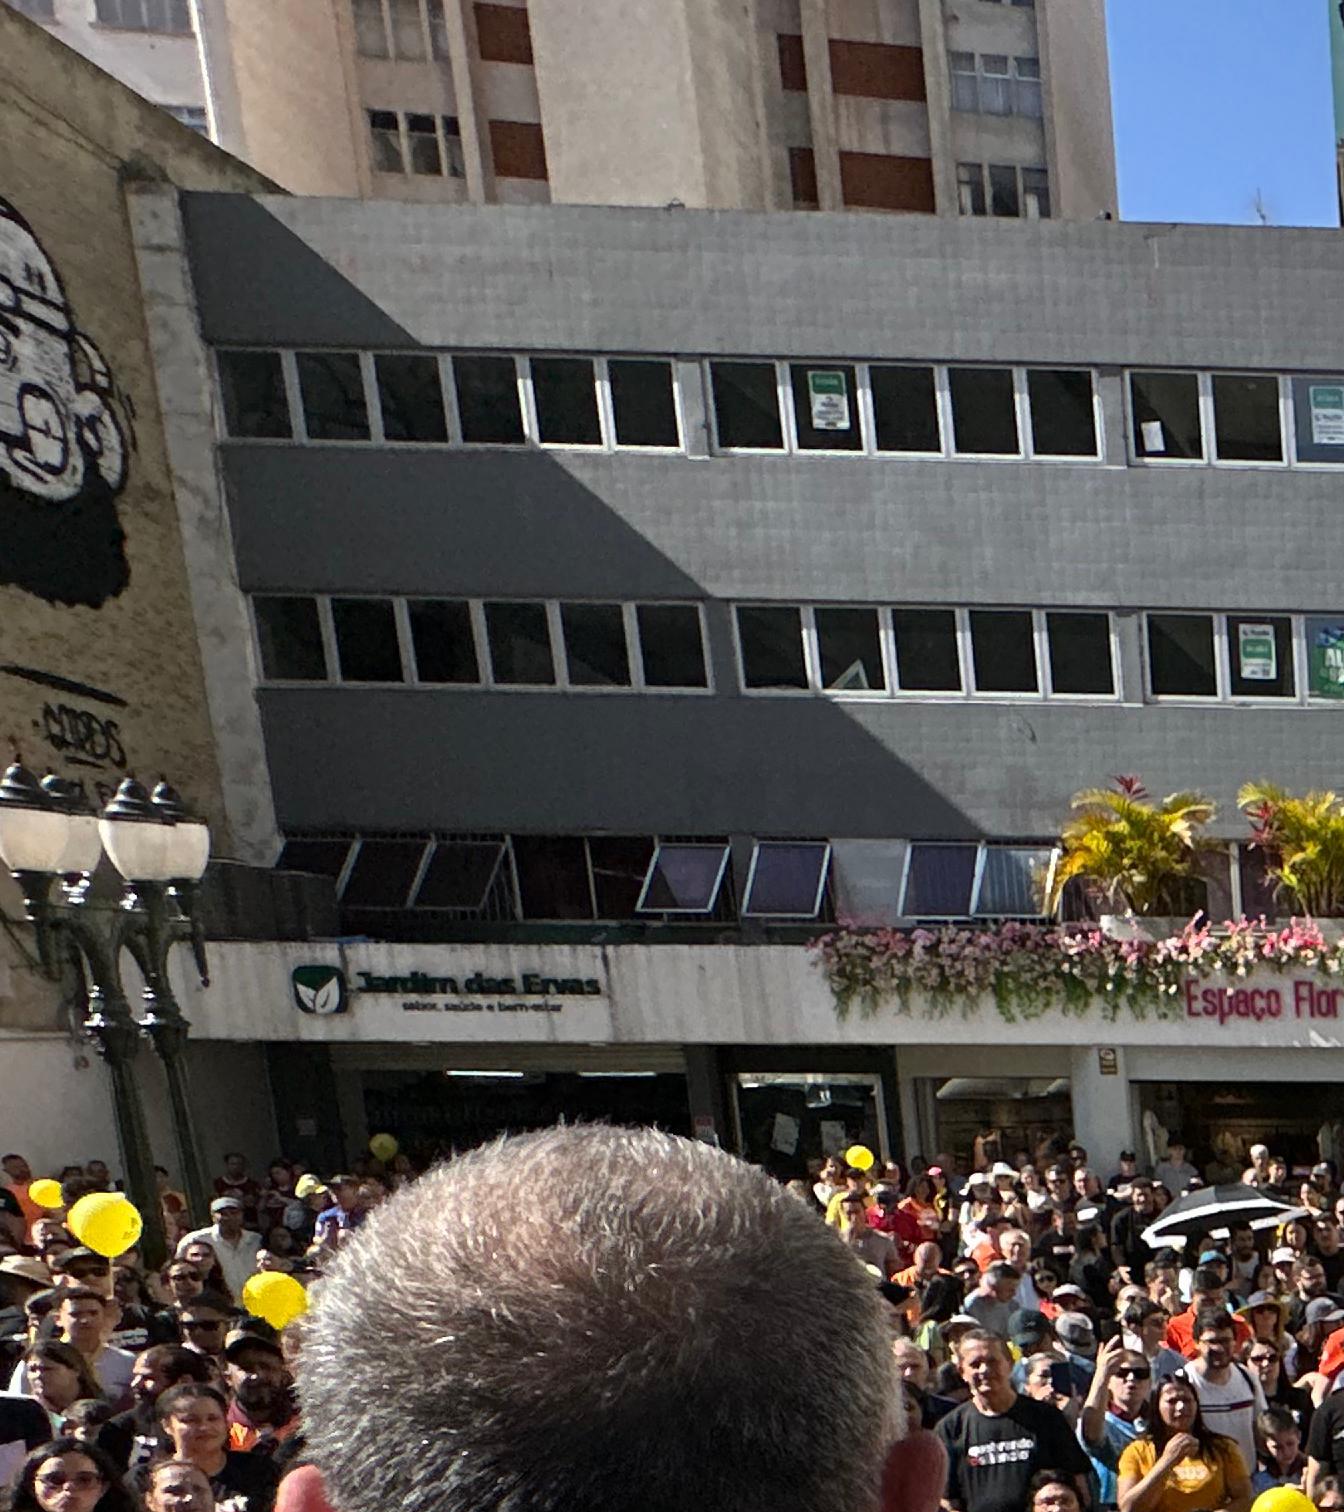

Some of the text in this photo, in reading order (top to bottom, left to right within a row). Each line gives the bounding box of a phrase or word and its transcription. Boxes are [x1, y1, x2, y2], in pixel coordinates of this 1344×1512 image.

[357, 971, 601, 995] Jardim das Ervas
[1185, 979, 1344, 1025] Espaço Flor
